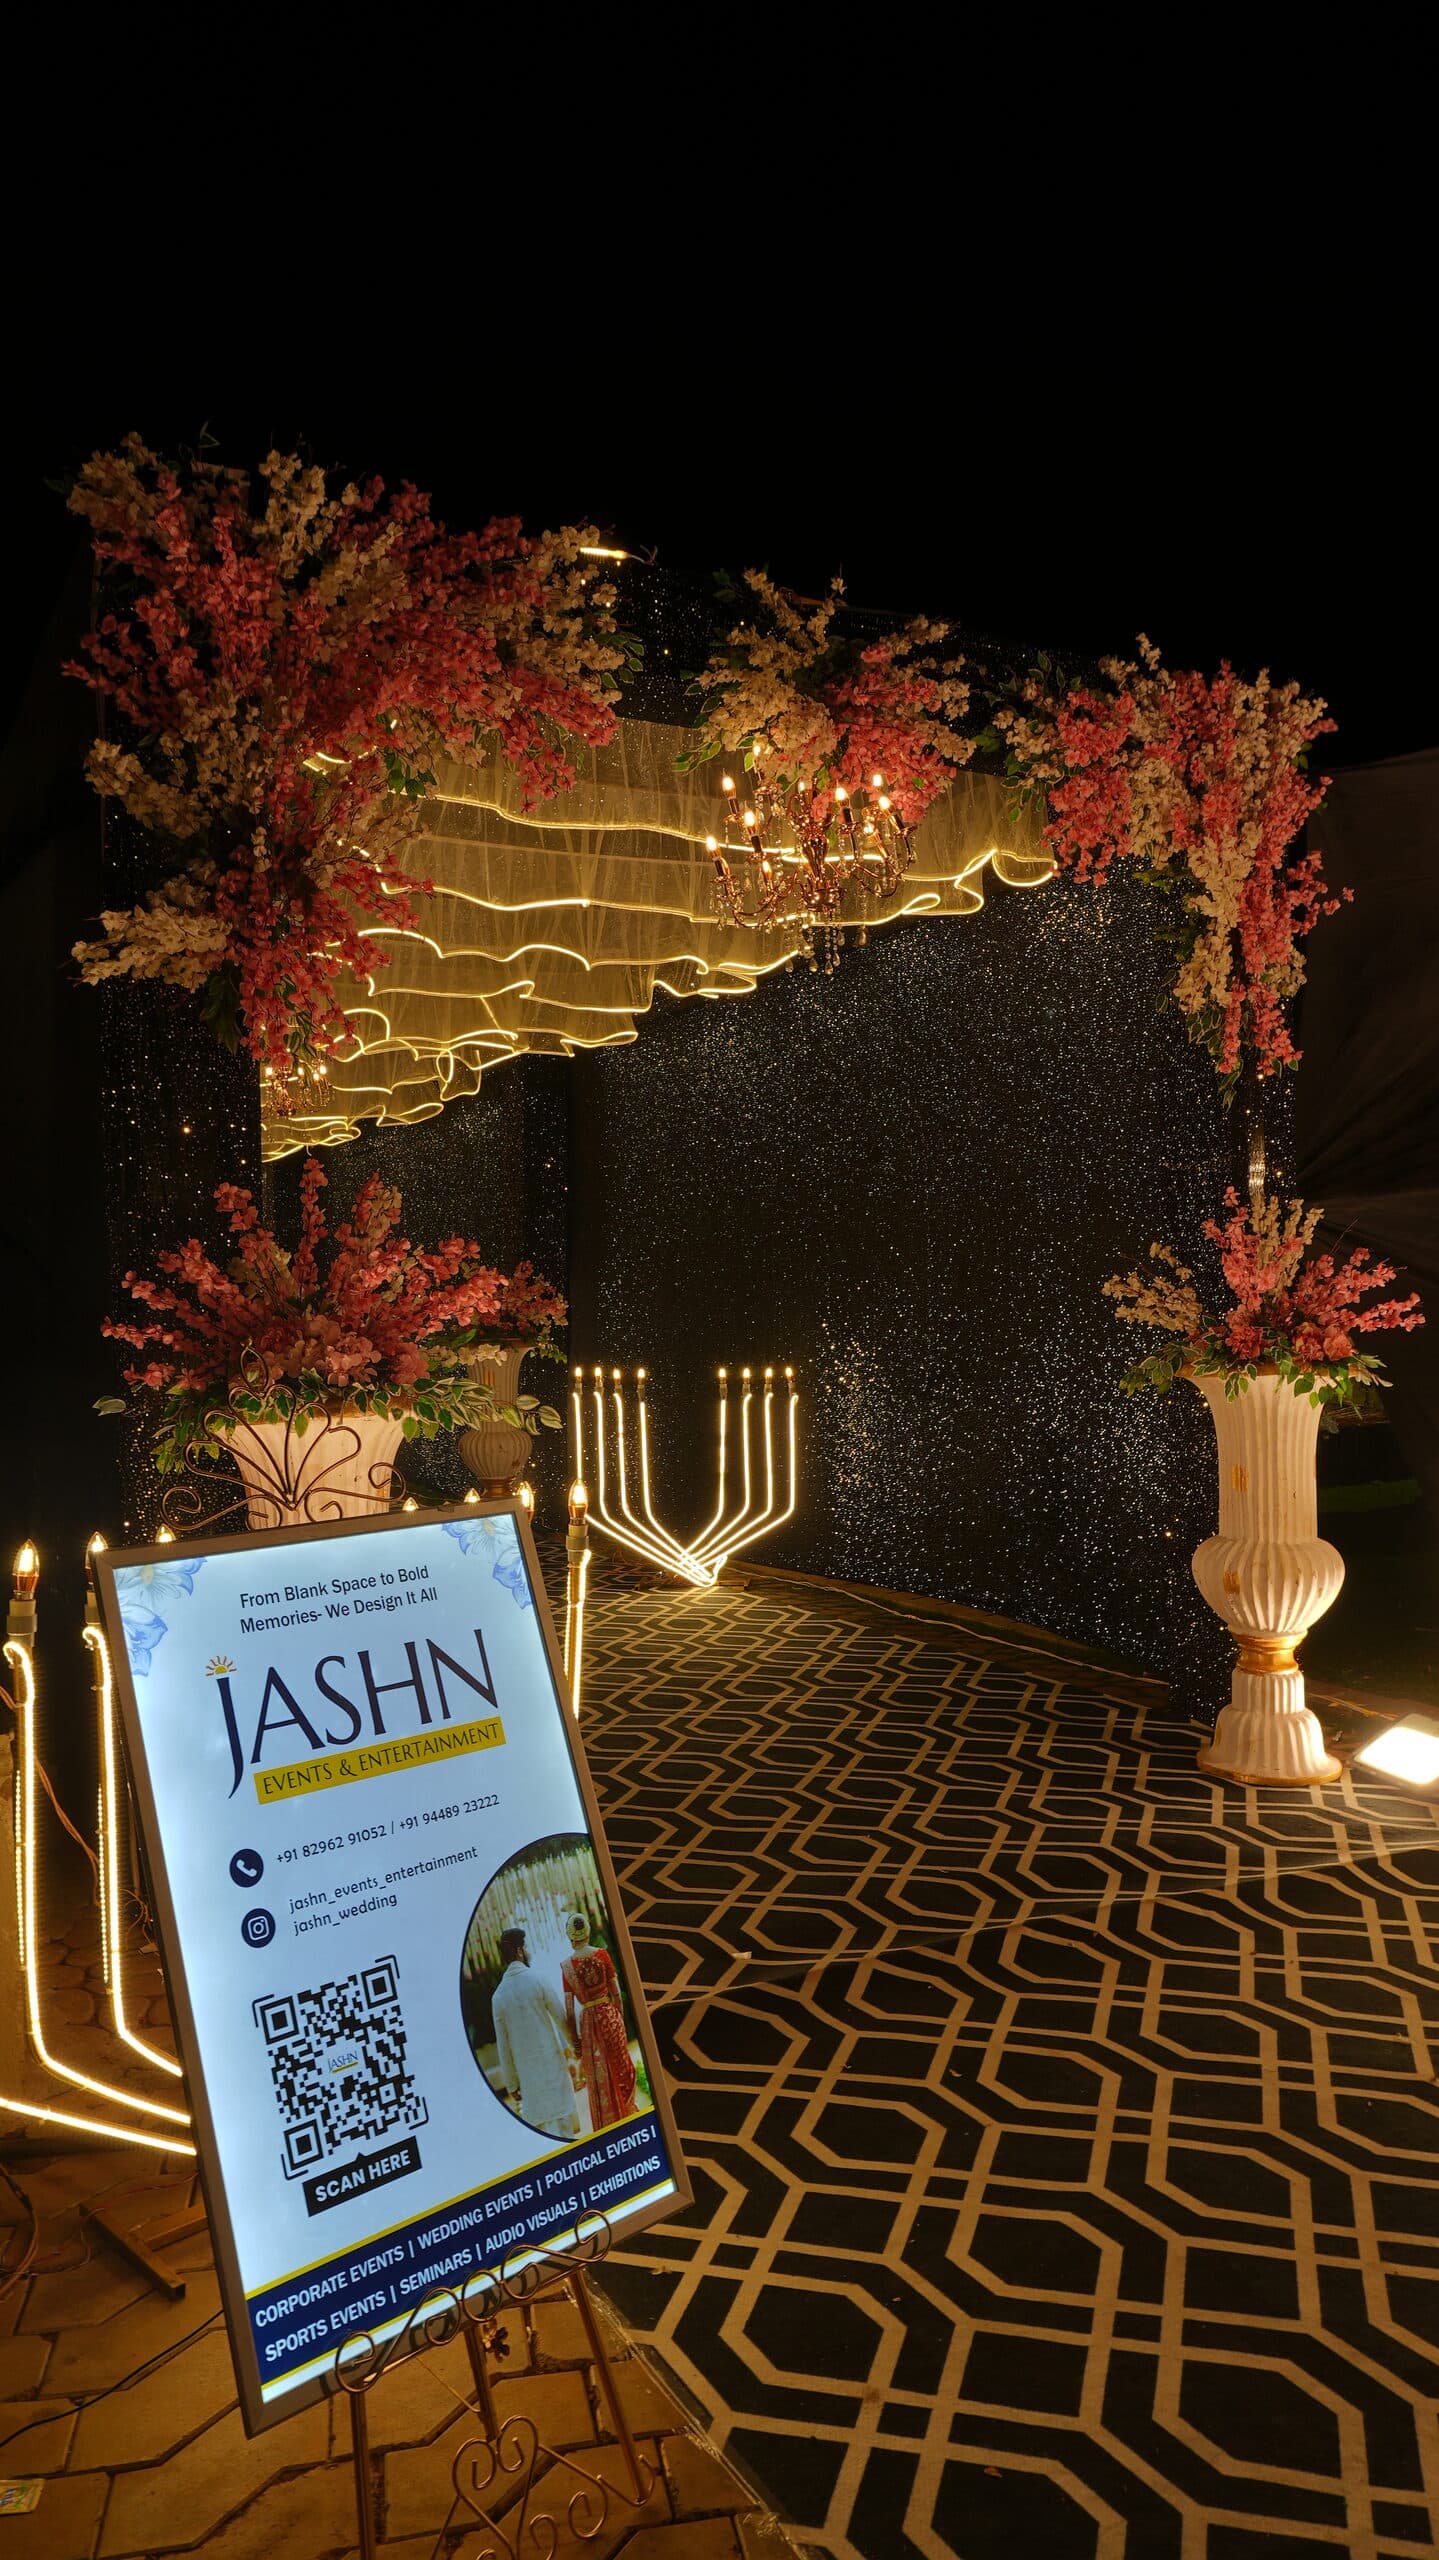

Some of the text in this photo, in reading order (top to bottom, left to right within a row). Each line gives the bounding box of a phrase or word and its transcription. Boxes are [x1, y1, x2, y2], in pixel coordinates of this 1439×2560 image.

[240, 1565, 429, 1608] From Blank Space to Bold
[240, 1587, 438, 1634] Memories- We Design It All
[216, 1629, 498, 1799] JASHN
[263, 1723, 498, 1794] EVENTS & ENTERTAINMENT
[277, 1848, 298, 1863] +91
[302, 1836, 344, 1857] 82962
[348, 1825, 387, 1845] 91052
[400, 1816, 419, 1829] +91
[422, 1805, 459, 1825] 94489
[463, 1794, 500, 1813] 23222
[289, 1846, 478, 1914] jashn_events_entertainment
[293, 1894, 397, 1936] jashn_wedding
[328, 2051, 359, 2072] JASHN
[315, 2149, 411, 2202] SCAN HERE
[255, 2271, 348, 2327] CORPORATE
[350, 2245, 404, 2283] EVENTS
[417, 2209, 483, 2249] WEDDING
[485, 2184, 533, 2218] EVENTS
[545, 2151, 606, 2189] POLITICAL
[606, 2129, 650, 2159] EVENTS
[265, 2319, 328, 2361] SPORTS
[330, 2291, 386, 2330] EVENTS
[400, 2249, 472, 2294] SEMINARS
[486, 2223, 525, 2253] AUDIO
[526, 2196, 578, 2231] VISUALS
[589, 2155, 660, 2201] EXHIBITIONS
